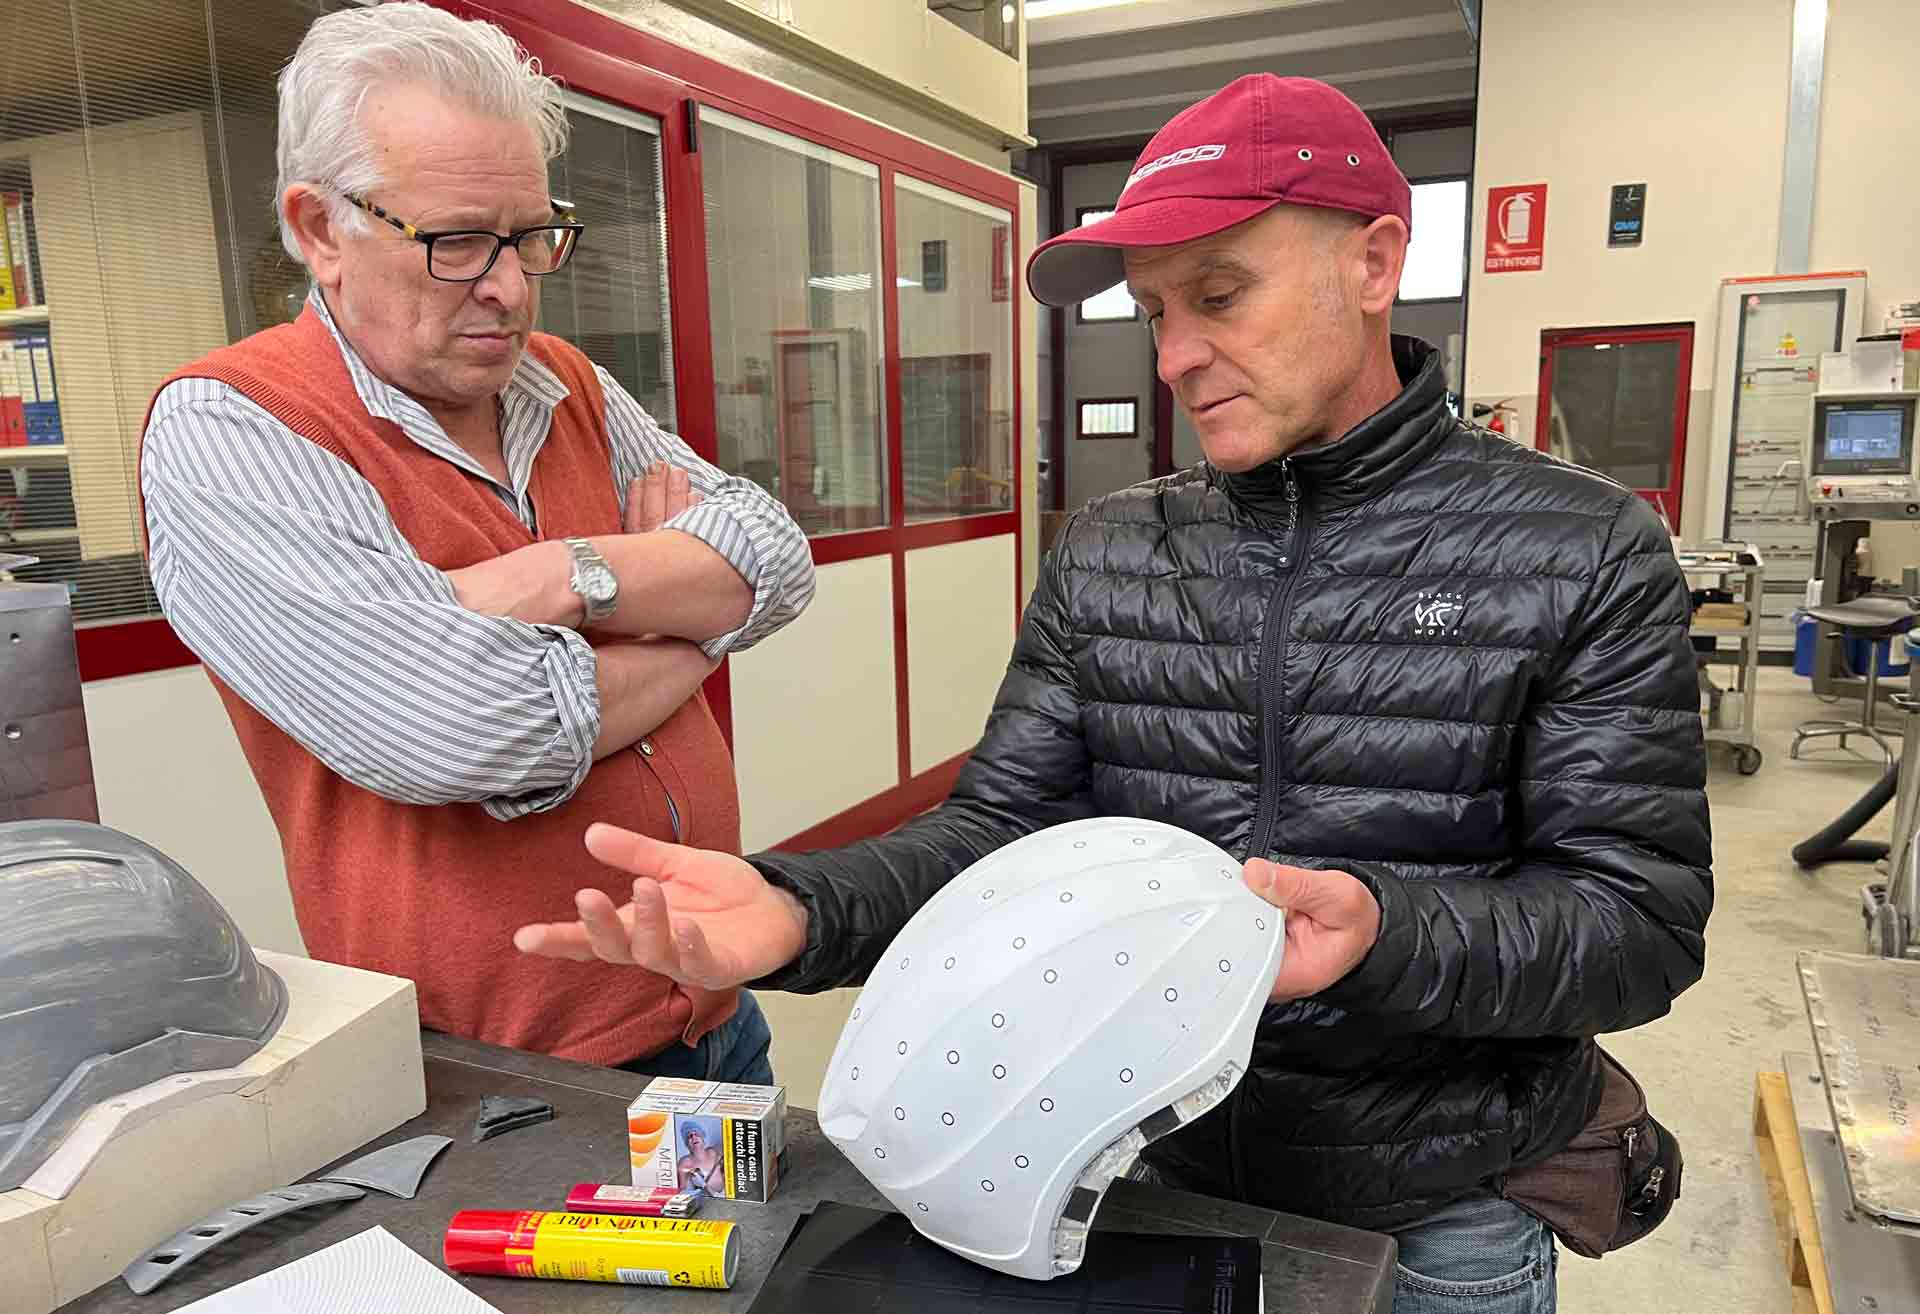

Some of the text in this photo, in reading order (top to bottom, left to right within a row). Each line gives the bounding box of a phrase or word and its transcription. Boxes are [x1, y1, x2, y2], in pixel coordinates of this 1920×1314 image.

[1486, 255, 1541, 268] ESTINTORE
[1418, 591, 1462, 599] BLACK
[735, 1121, 748, 1193] attacchi cardiaci
[747, 1122, 758, 1182] Il fumo causa
